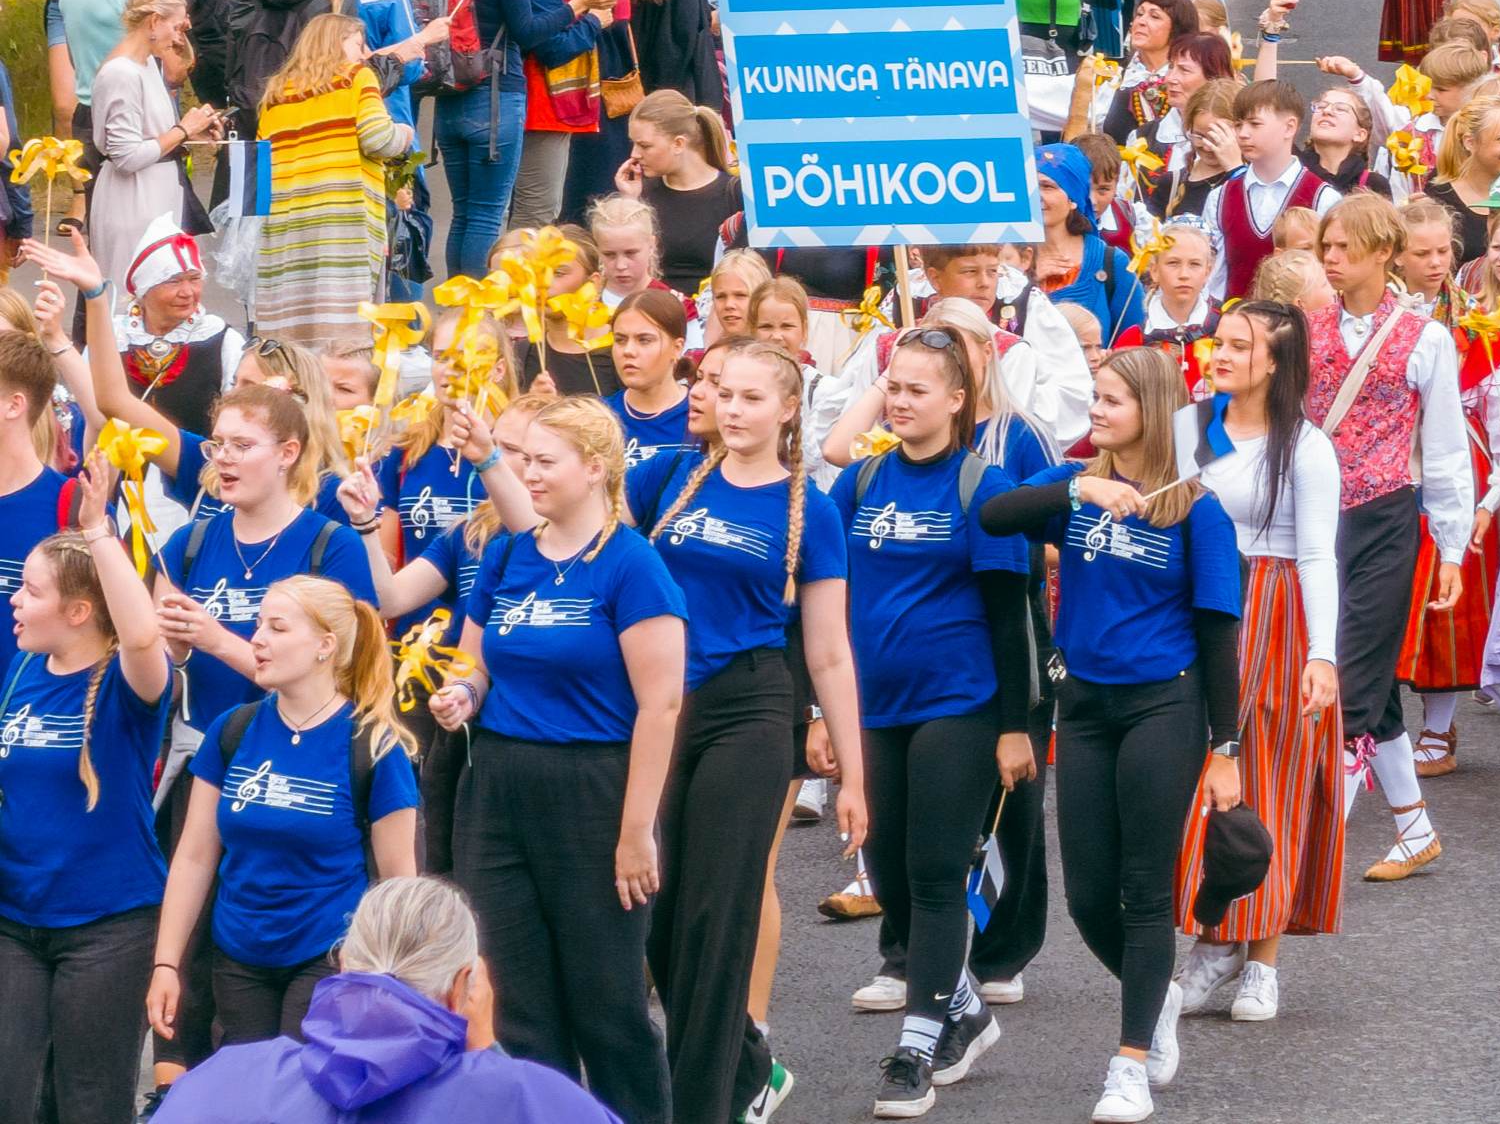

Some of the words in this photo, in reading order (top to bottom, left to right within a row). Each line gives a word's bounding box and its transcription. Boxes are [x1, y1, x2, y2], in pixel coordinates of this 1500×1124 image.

[743, 64, 879, 95] KUNINGA
[885, 56, 1010, 91] TÄNAVA
[763, 152, 1016, 207] PÕHIKOOL
